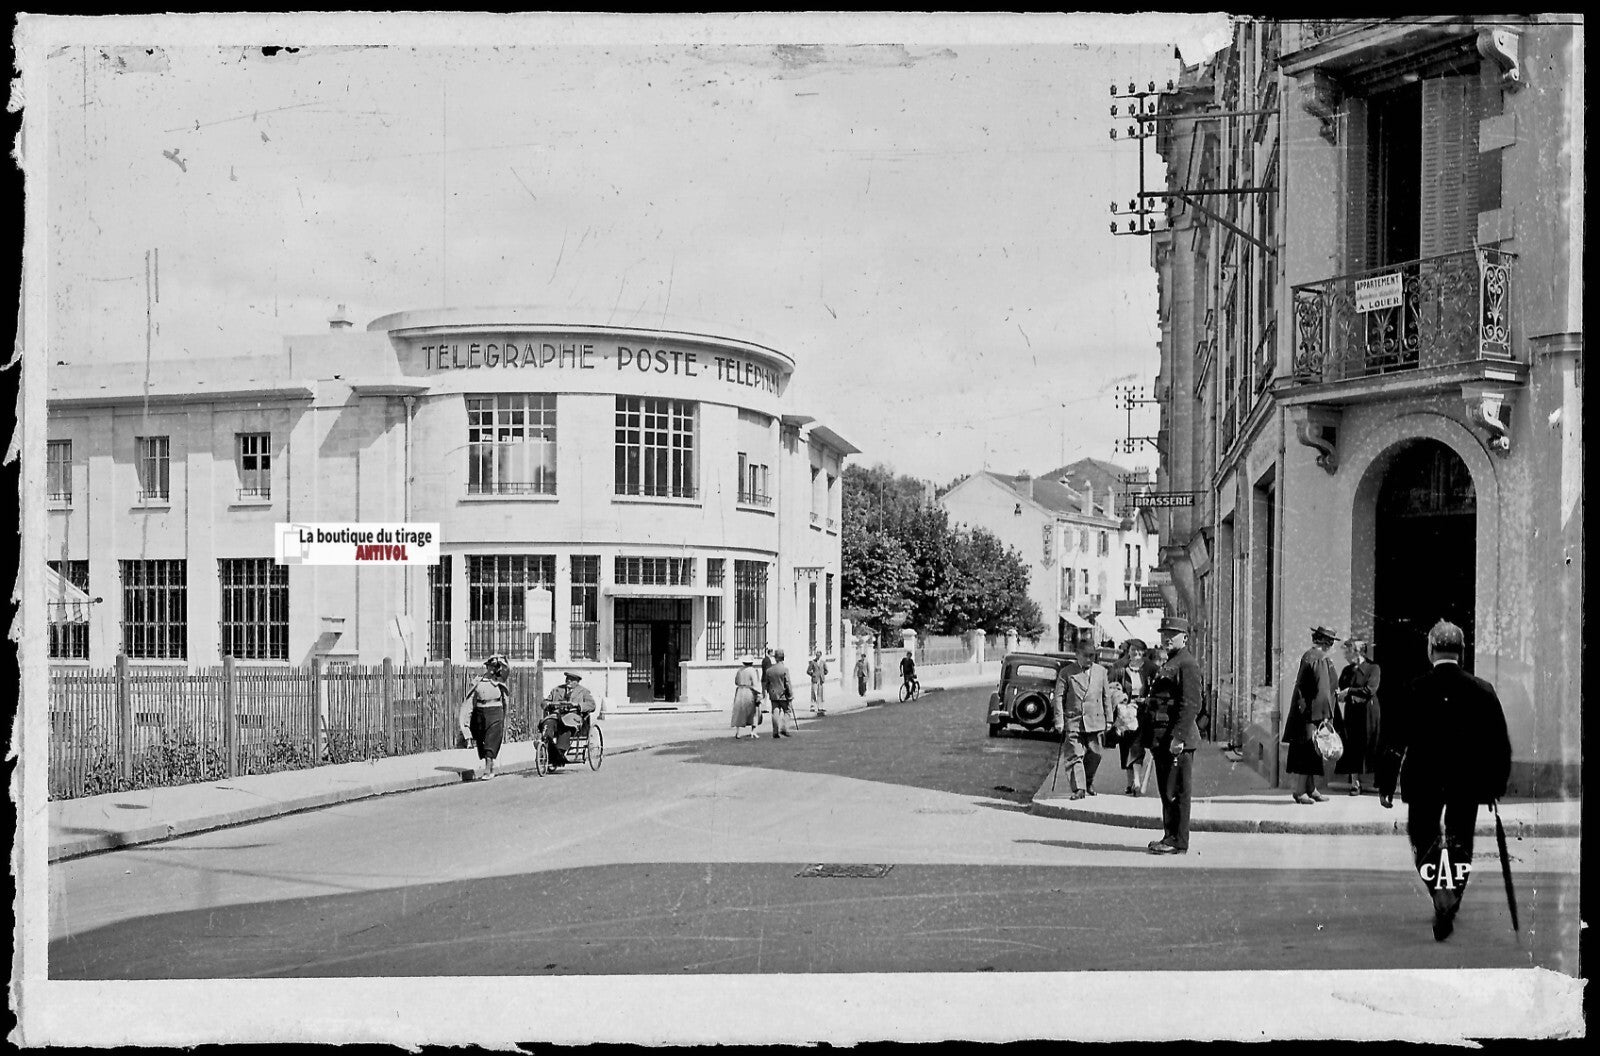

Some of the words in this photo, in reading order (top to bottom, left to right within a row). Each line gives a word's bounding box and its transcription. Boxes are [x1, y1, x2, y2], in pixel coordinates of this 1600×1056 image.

[1356, 275, 1399, 291] APPARTEMENT
[1369, 297, 1399, 310] LOUER
[617, 346, 698, 377] POSTE
[1135, 496, 1193, 506] BRASSERIE
